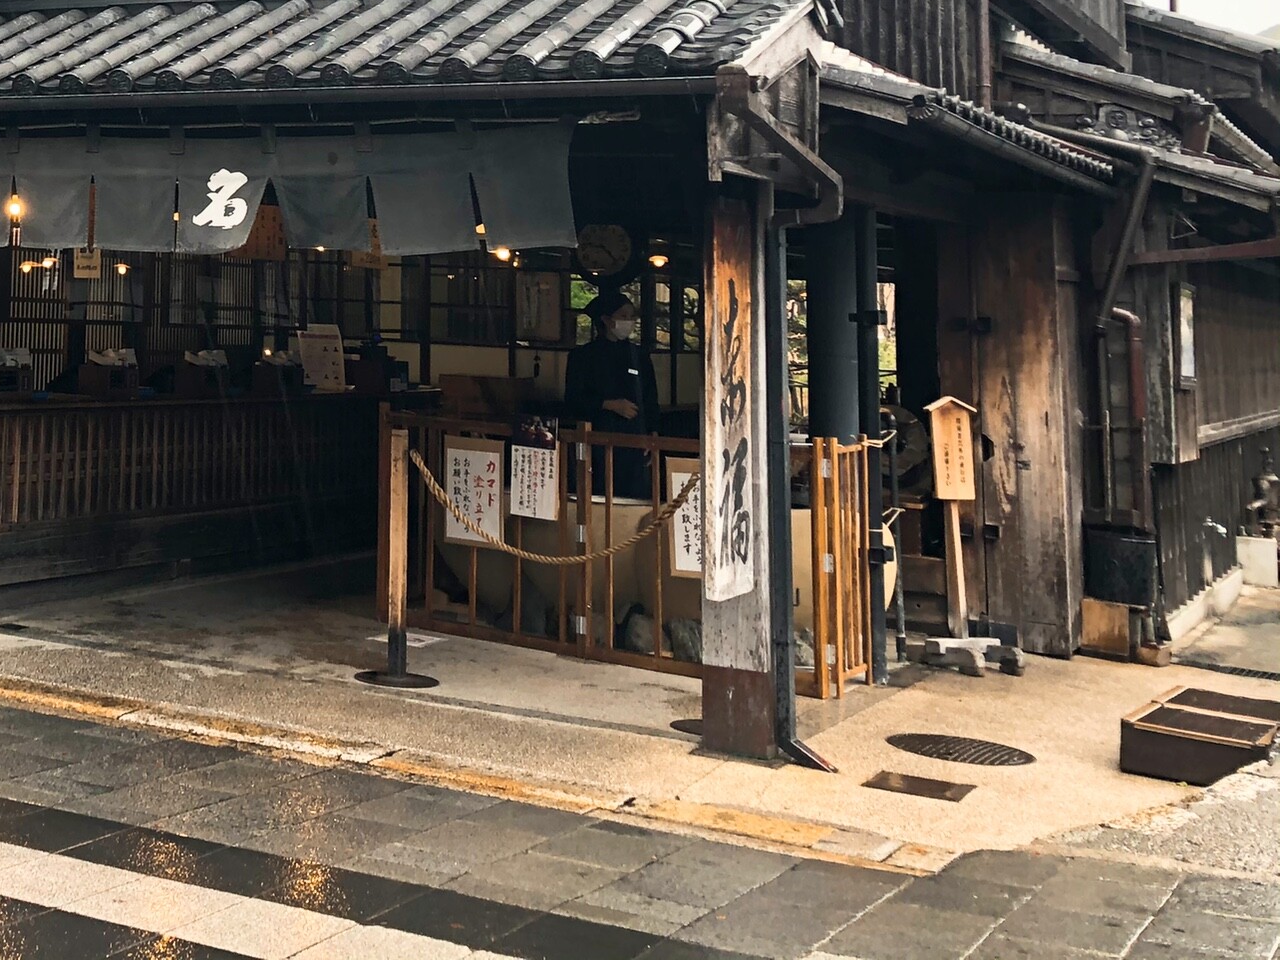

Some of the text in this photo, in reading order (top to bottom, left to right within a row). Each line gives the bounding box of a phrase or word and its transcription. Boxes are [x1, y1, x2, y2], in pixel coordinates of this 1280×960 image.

[463, 458, 471, 533] お手をふれないう
[486, 460, 496, 508] カマド
